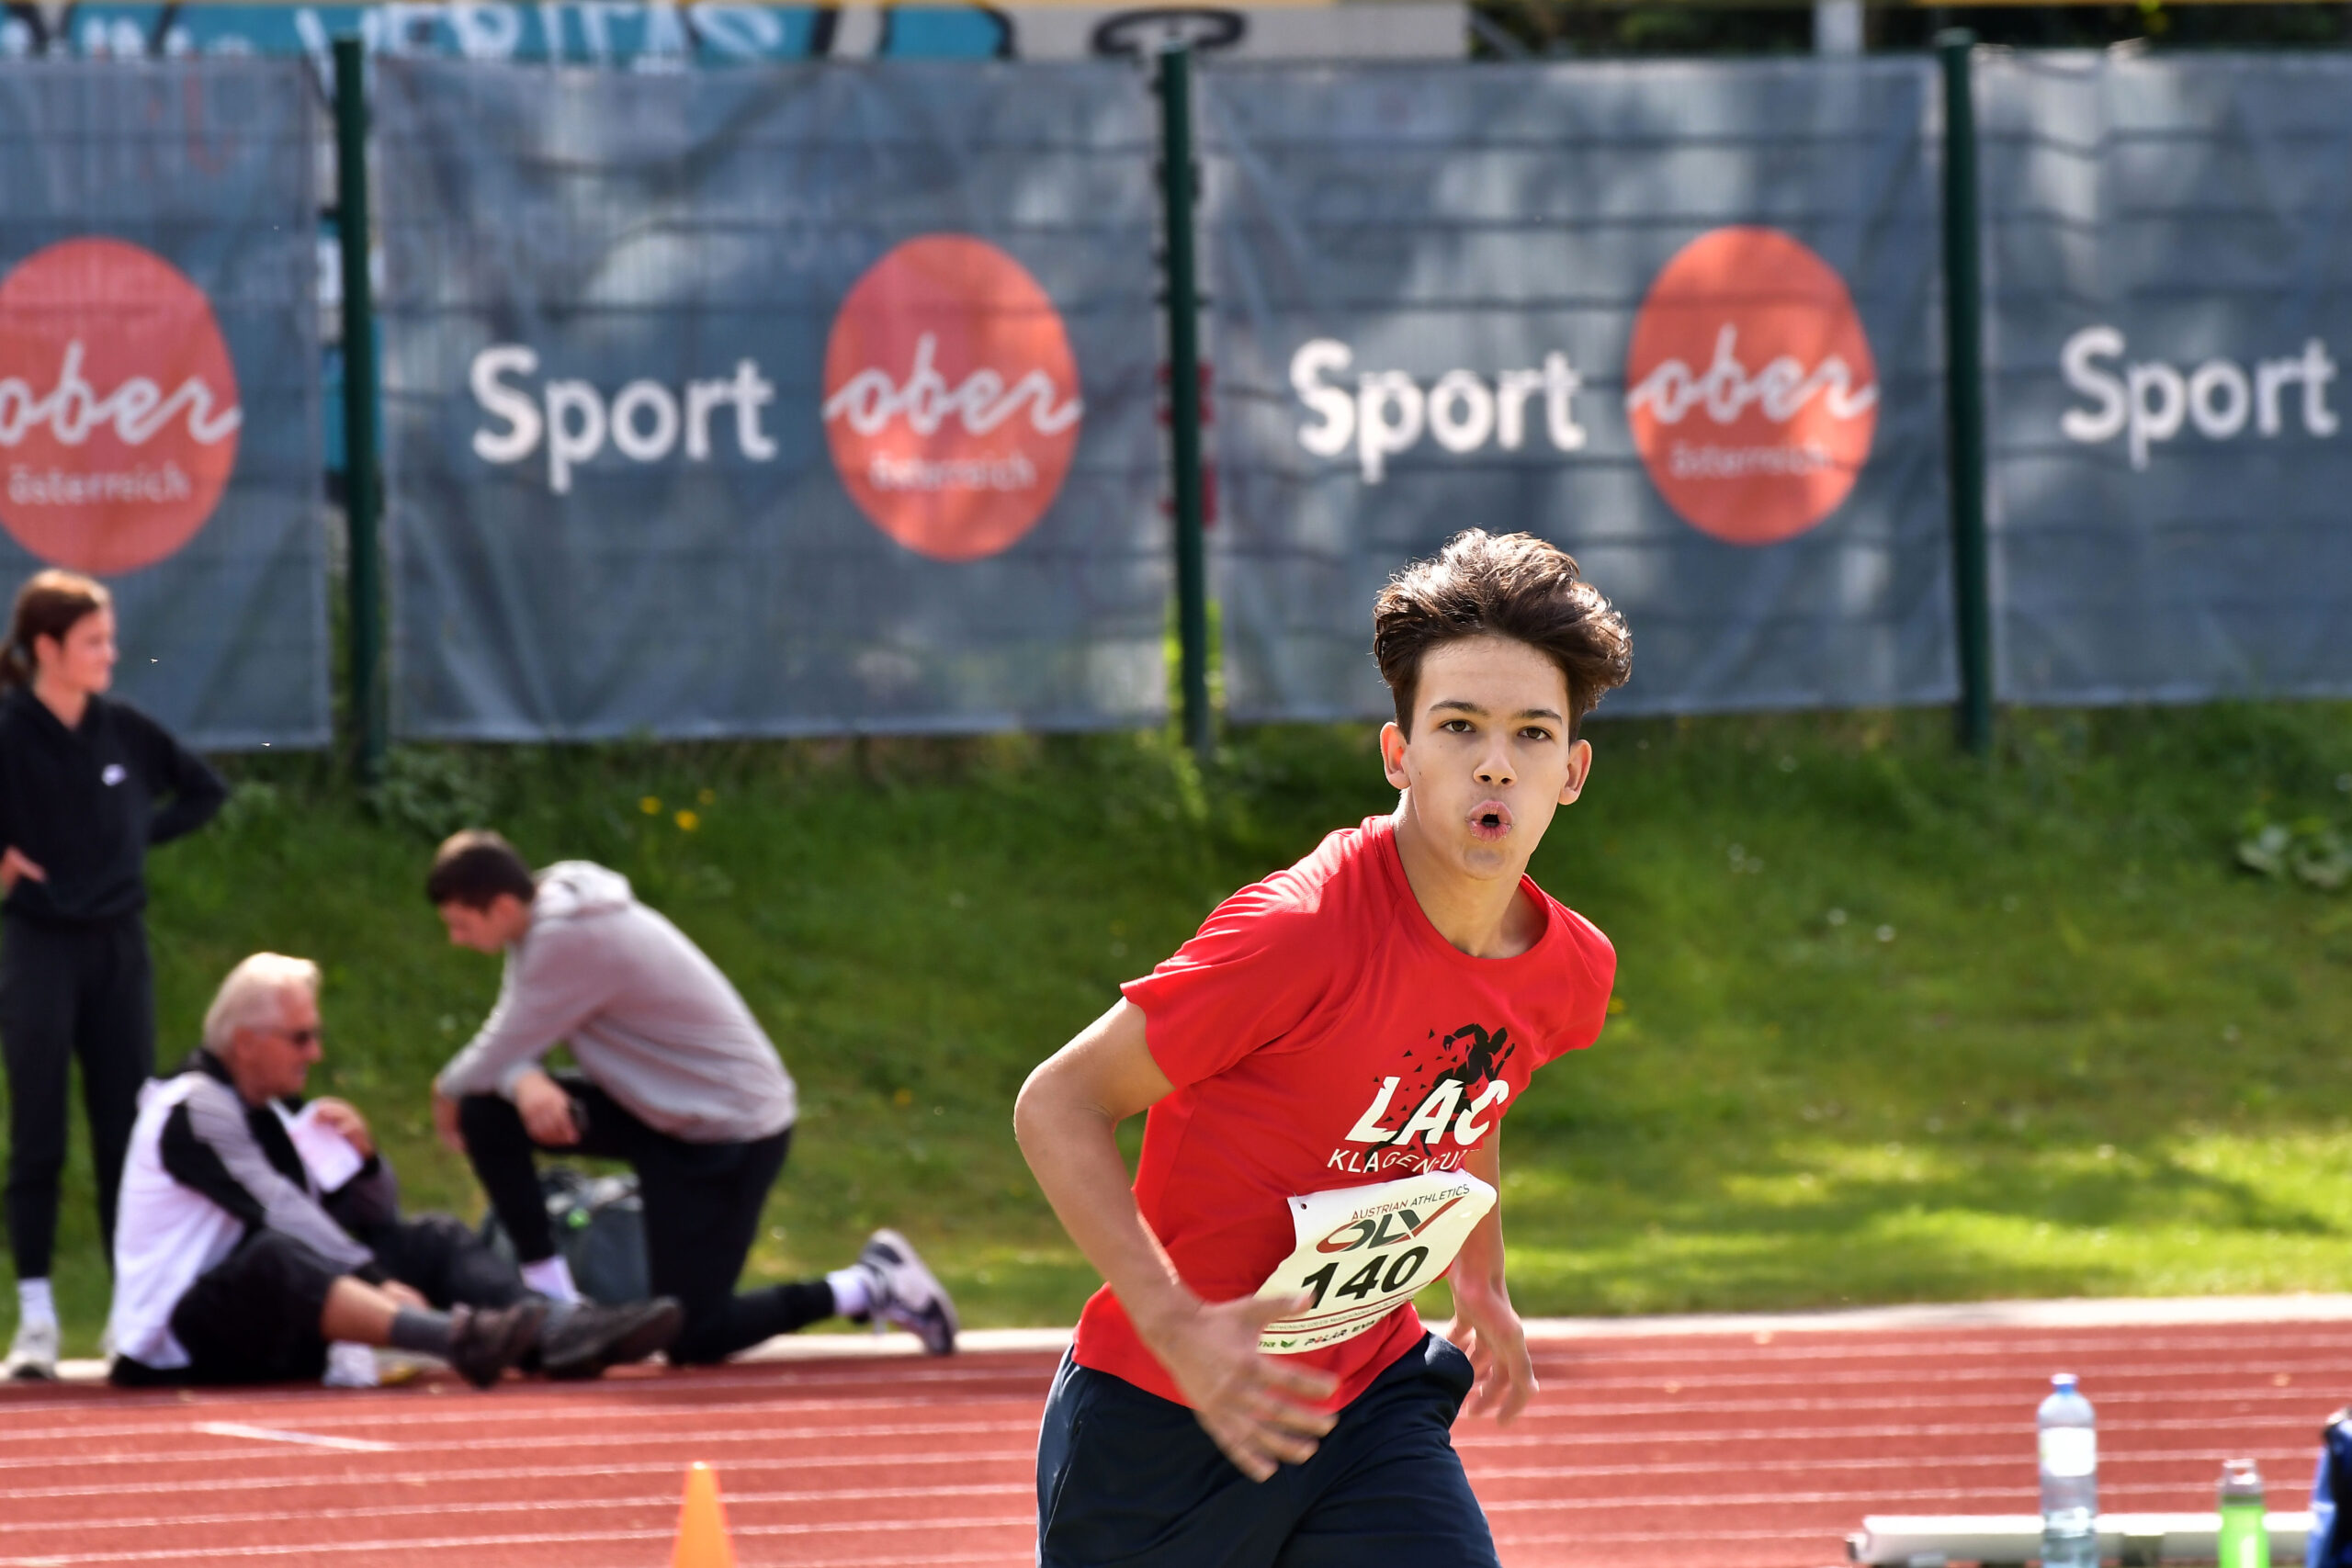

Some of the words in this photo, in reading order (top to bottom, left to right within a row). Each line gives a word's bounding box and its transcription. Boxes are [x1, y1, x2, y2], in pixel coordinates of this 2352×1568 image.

[0, 338, 243, 446] ober
[470, 344, 775, 494] Sport
[823, 333, 1084, 436] ober
[1289, 339, 1586, 485] Sport
[1625, 323, 1880, 424] ober
[2059, 325, 2339, 471] Sport
[1327, 1148, 1472, 1174] KLAGENFU
[1344, 1076, 1510, 1145] LAC
[1351, 1199, 1409, 1222] AUSTRIAN
[1410, 1183, 1470, 1207] ATHLETICS
[1301, 1246, 1430, 1309] 140
